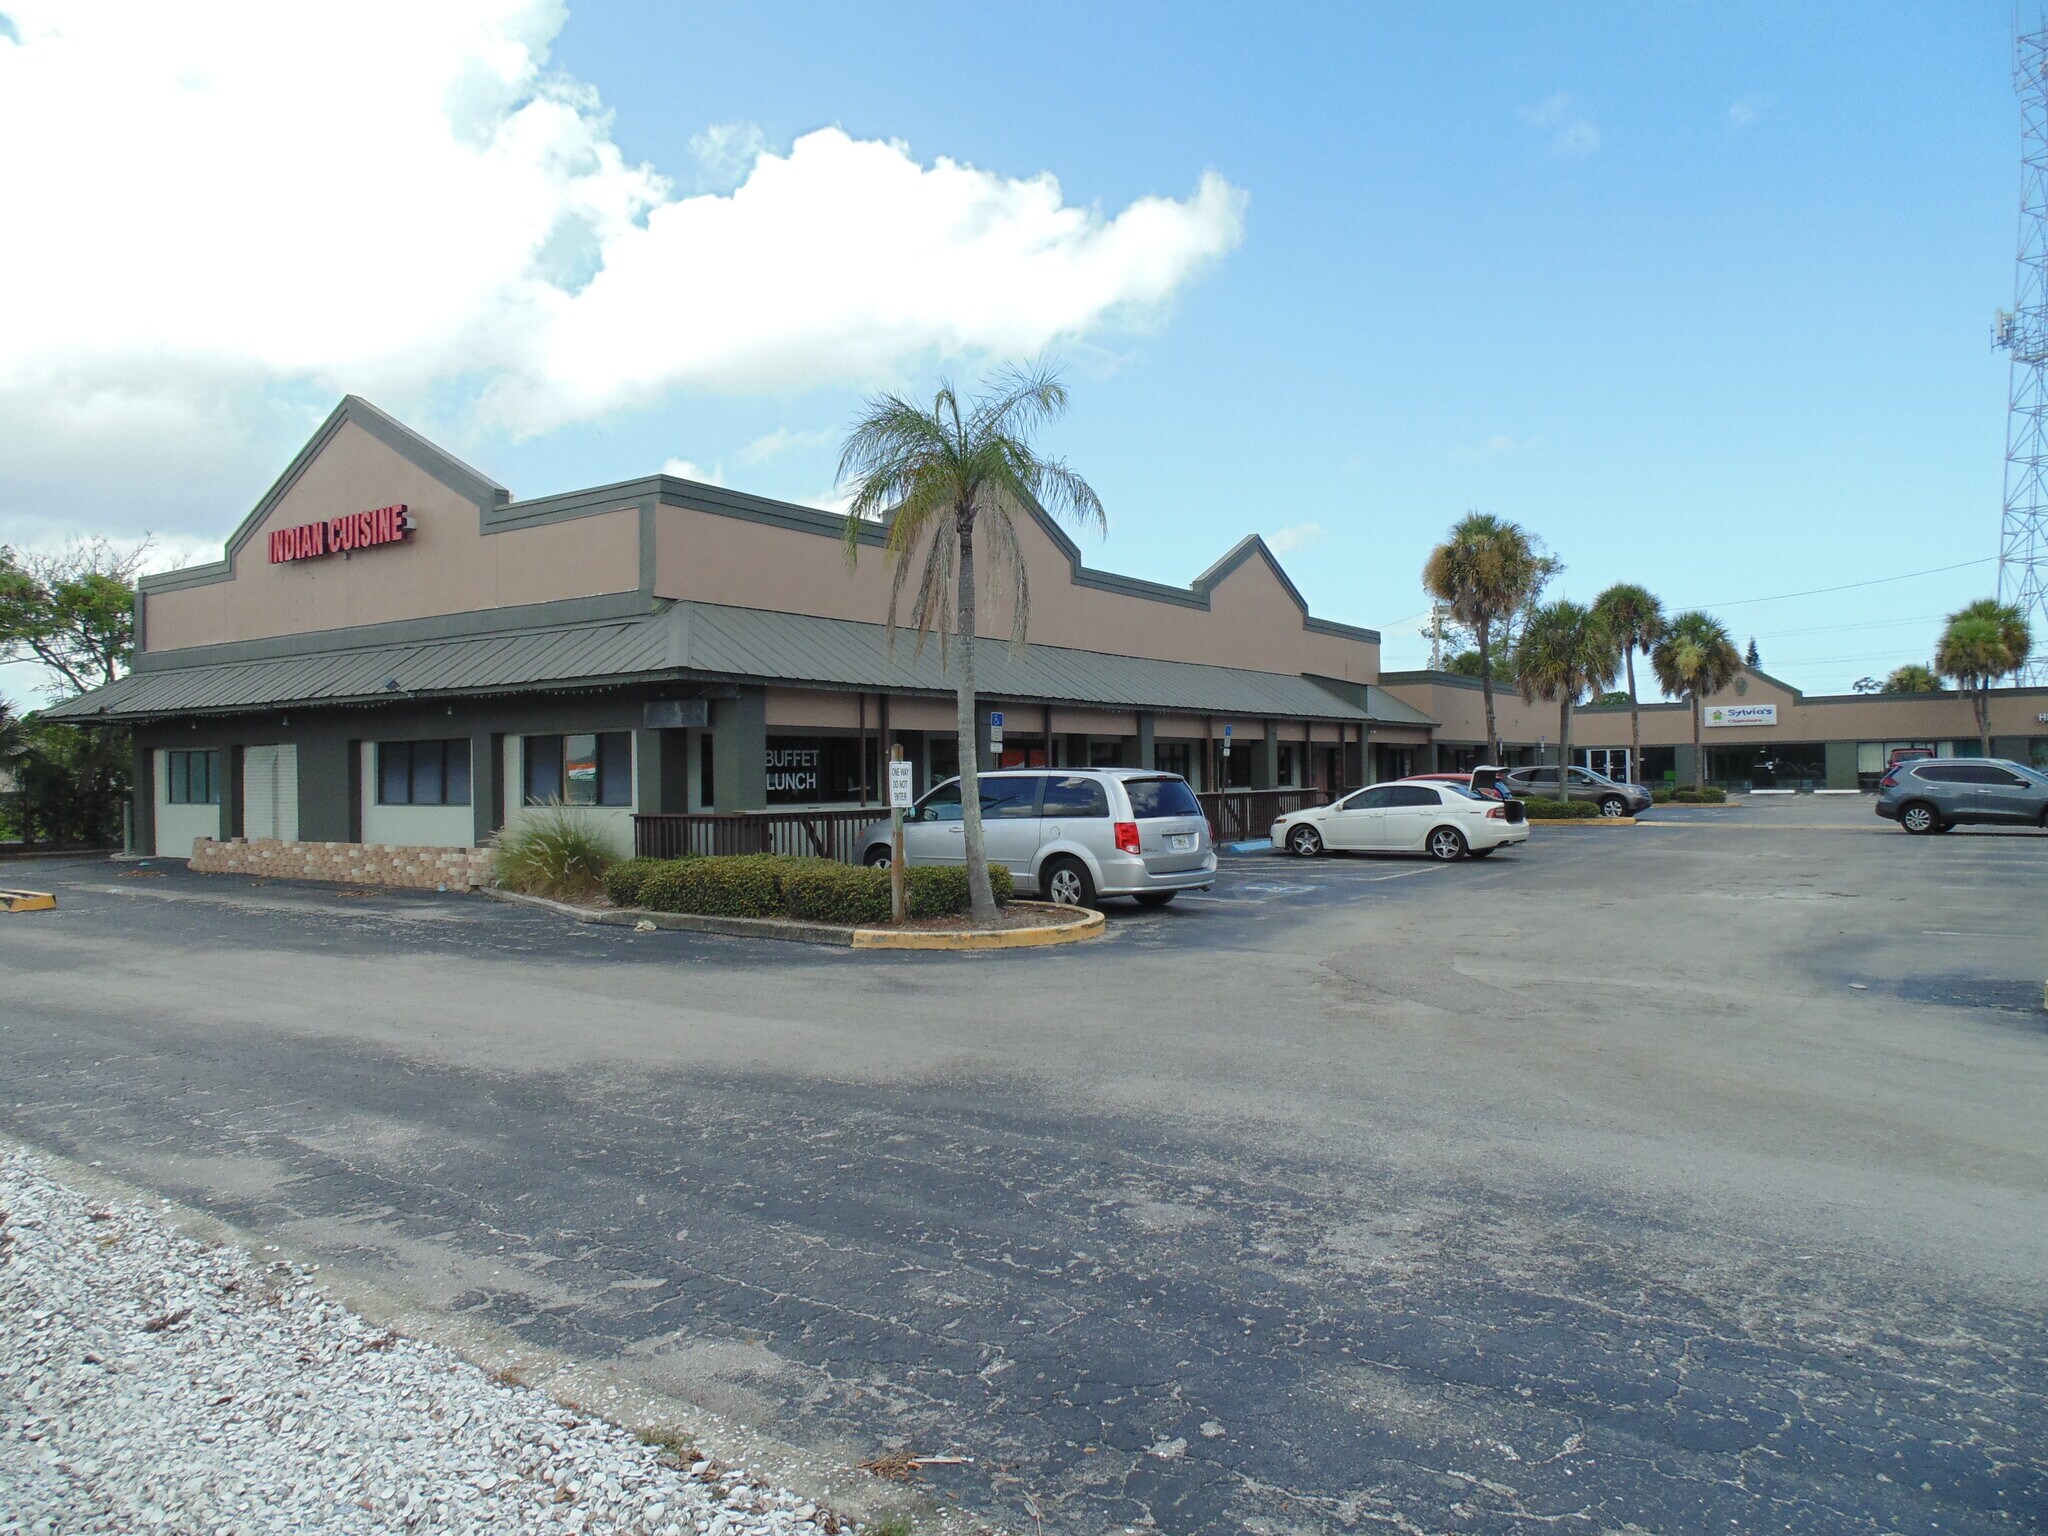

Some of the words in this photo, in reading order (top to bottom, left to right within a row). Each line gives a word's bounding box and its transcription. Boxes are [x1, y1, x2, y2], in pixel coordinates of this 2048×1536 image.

[268, 522, 327, 564] INDIAN
[328, 504, 407, 553] CUISINE
[1727, 708, 1773, 717] Sylvia's
[765, 750, 819, 767] BUFFET
[892, 767, 900, 777] ONE
[900, 767, 909, 777] WAY
[766, 773, 816, 790] LUNCH
[893, 780, 899, 789] DO
[899, 780, 908, 789] NOT
[894, 792, 908, 801] ENTER
